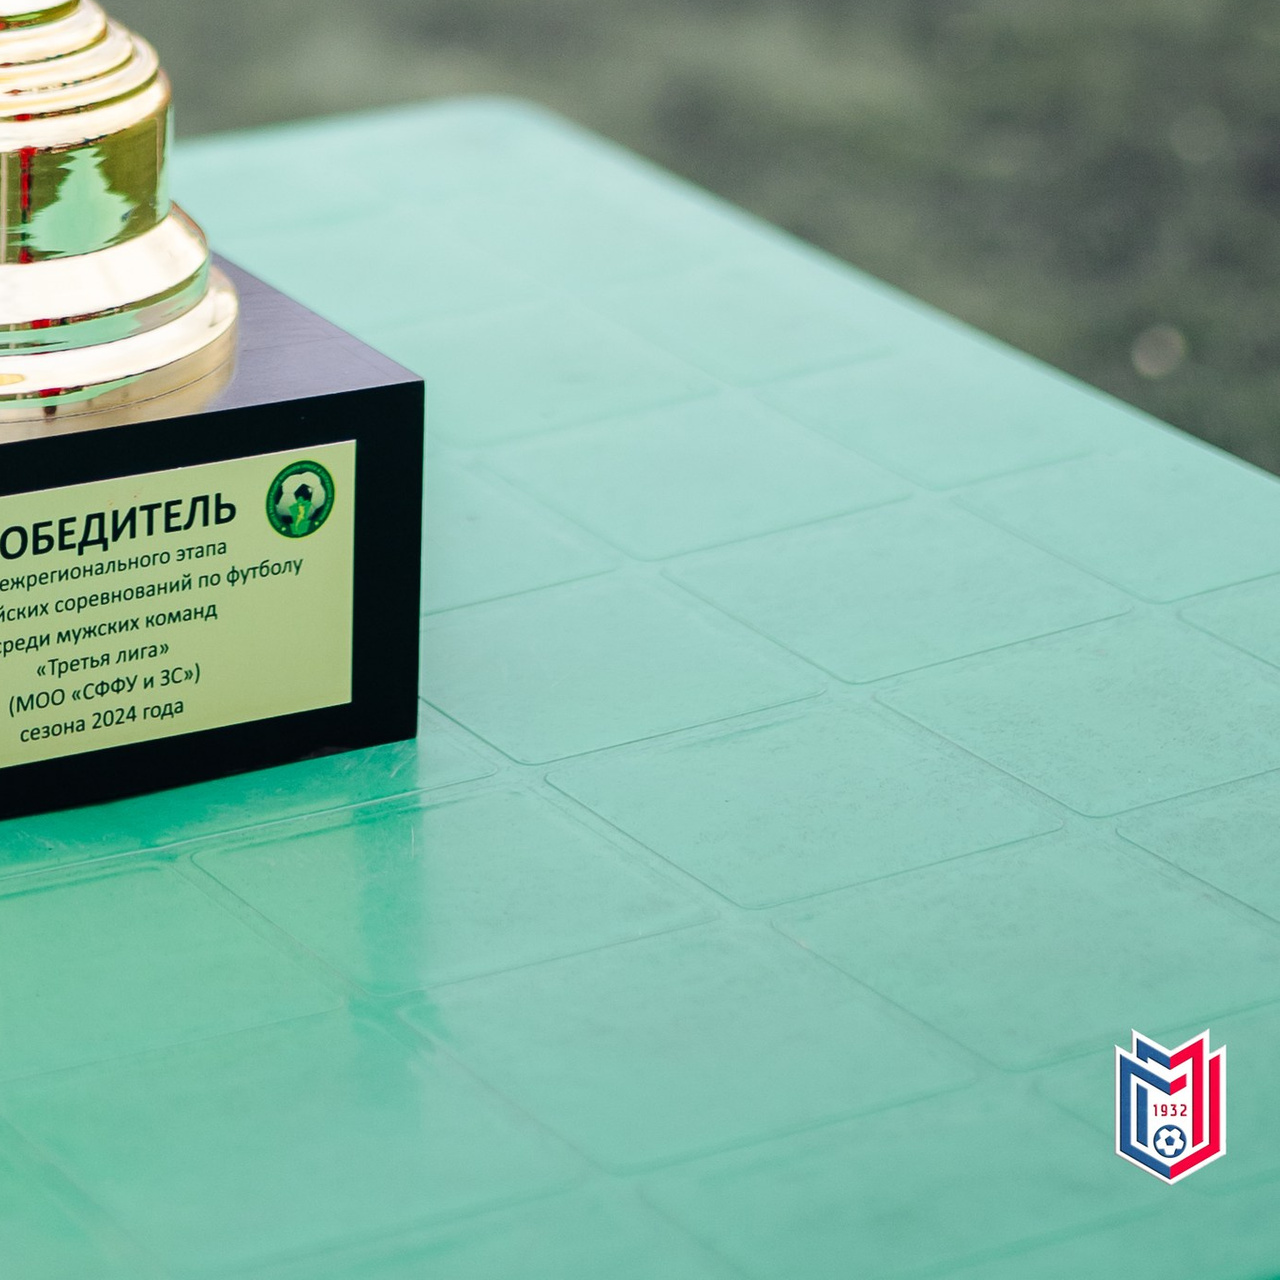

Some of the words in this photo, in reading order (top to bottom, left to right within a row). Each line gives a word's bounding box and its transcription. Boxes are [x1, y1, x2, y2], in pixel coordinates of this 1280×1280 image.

[175, 541, 227, 562] этапа
[54, 572, 193, 615] соревнований
[198, 572, 222, 589] по
[225, 556, 304, 587] футболу
[55, 617, 141, 646] мужских
[145, 603, 219, 629] команд
[36, 650, 111, 679] «Третья
[115, 643, 170, 664] лига»
[8, 688, 66, 719] (МОО
[71, 674, 139, 702] «СФФУ
[143, 675, 155, 690] и
[159, 662, 201, 687] ЗС»)
[19, 718, 86, 743] сезона
[91, 704, 138, 731] 2024
[142, 699, 185, 722] года
